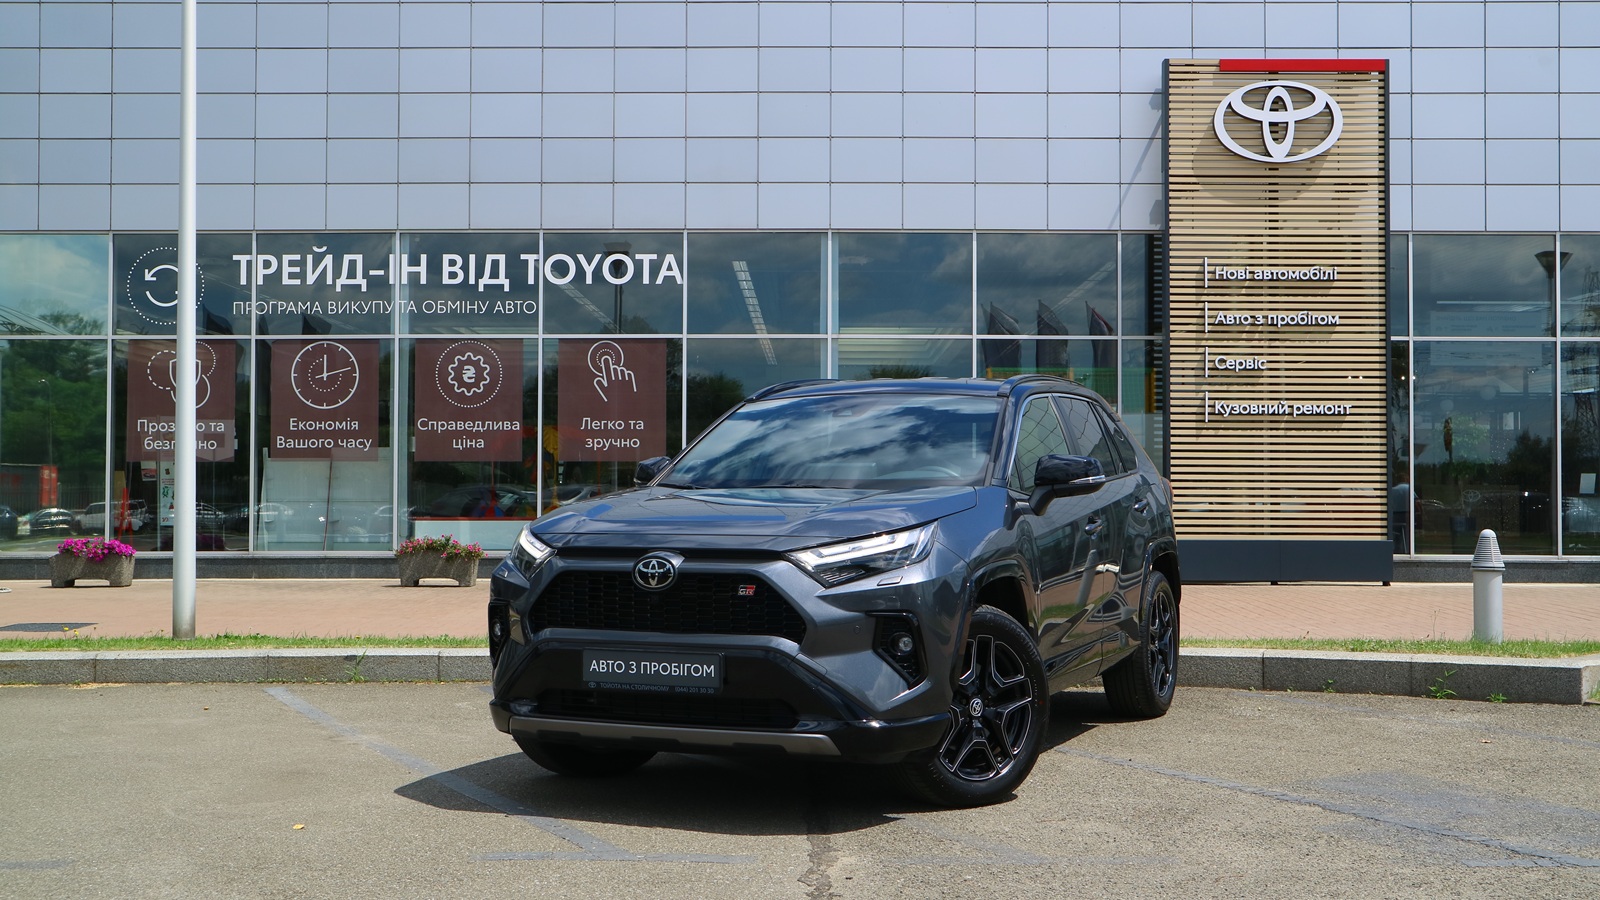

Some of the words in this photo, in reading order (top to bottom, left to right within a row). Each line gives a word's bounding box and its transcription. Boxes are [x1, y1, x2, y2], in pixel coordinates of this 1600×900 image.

[232, 246, 428, 292] ТРЕЙД-ІН
[442, 253, 510, 292] ВІД
[520, 253, 684, 285] TOYOTA
[1214, 266, 1249, 280] Нові
[1254, 266, 1338, 281] автомобілі
[233, 301, 322, 315] ПРОГРАМА
[328, 300, 395, 314] ВИКУПУ
[399, 300, 418, 314] ТА
[422, 300, 489, 314] ОБМІНУ
[493, 300, 537, 314] АВТО
[1214, 311, 1250, 325] Авто
[1254, 313, 1263, 325] з
[1267, 311, 1340, 328] пробігом
[1214, 355, 1267, 372] Сервіс
[1214, 400, 1289, 418] Кузовний
[1292, 403, 1352, 418] ремонт
[137, 419, 206, 435] Прозо
[209, 422, 225, 432] та
[289, 418, 359, 431] Економія
[417, 418, 521, 434] Справедлива
[580, 417, 625, 430] Легко
[629, 420, 645, 430] та
[144, 436, 217, 450] безно
[276, 435, 334, 449] Вашого
[338, 438, 372, 451] часу
[453, 435, 485, 450] ціна
[585, 438, 640, 451] зручно
[738, 588, 755, 596] GR
[589, 659, 625, 674] АВТО
[628, 661, 637, 674] З
[640, 661, 715, 678] ПРОБІГОМ
[600, 682, 622, 690] ТОЙОТА
